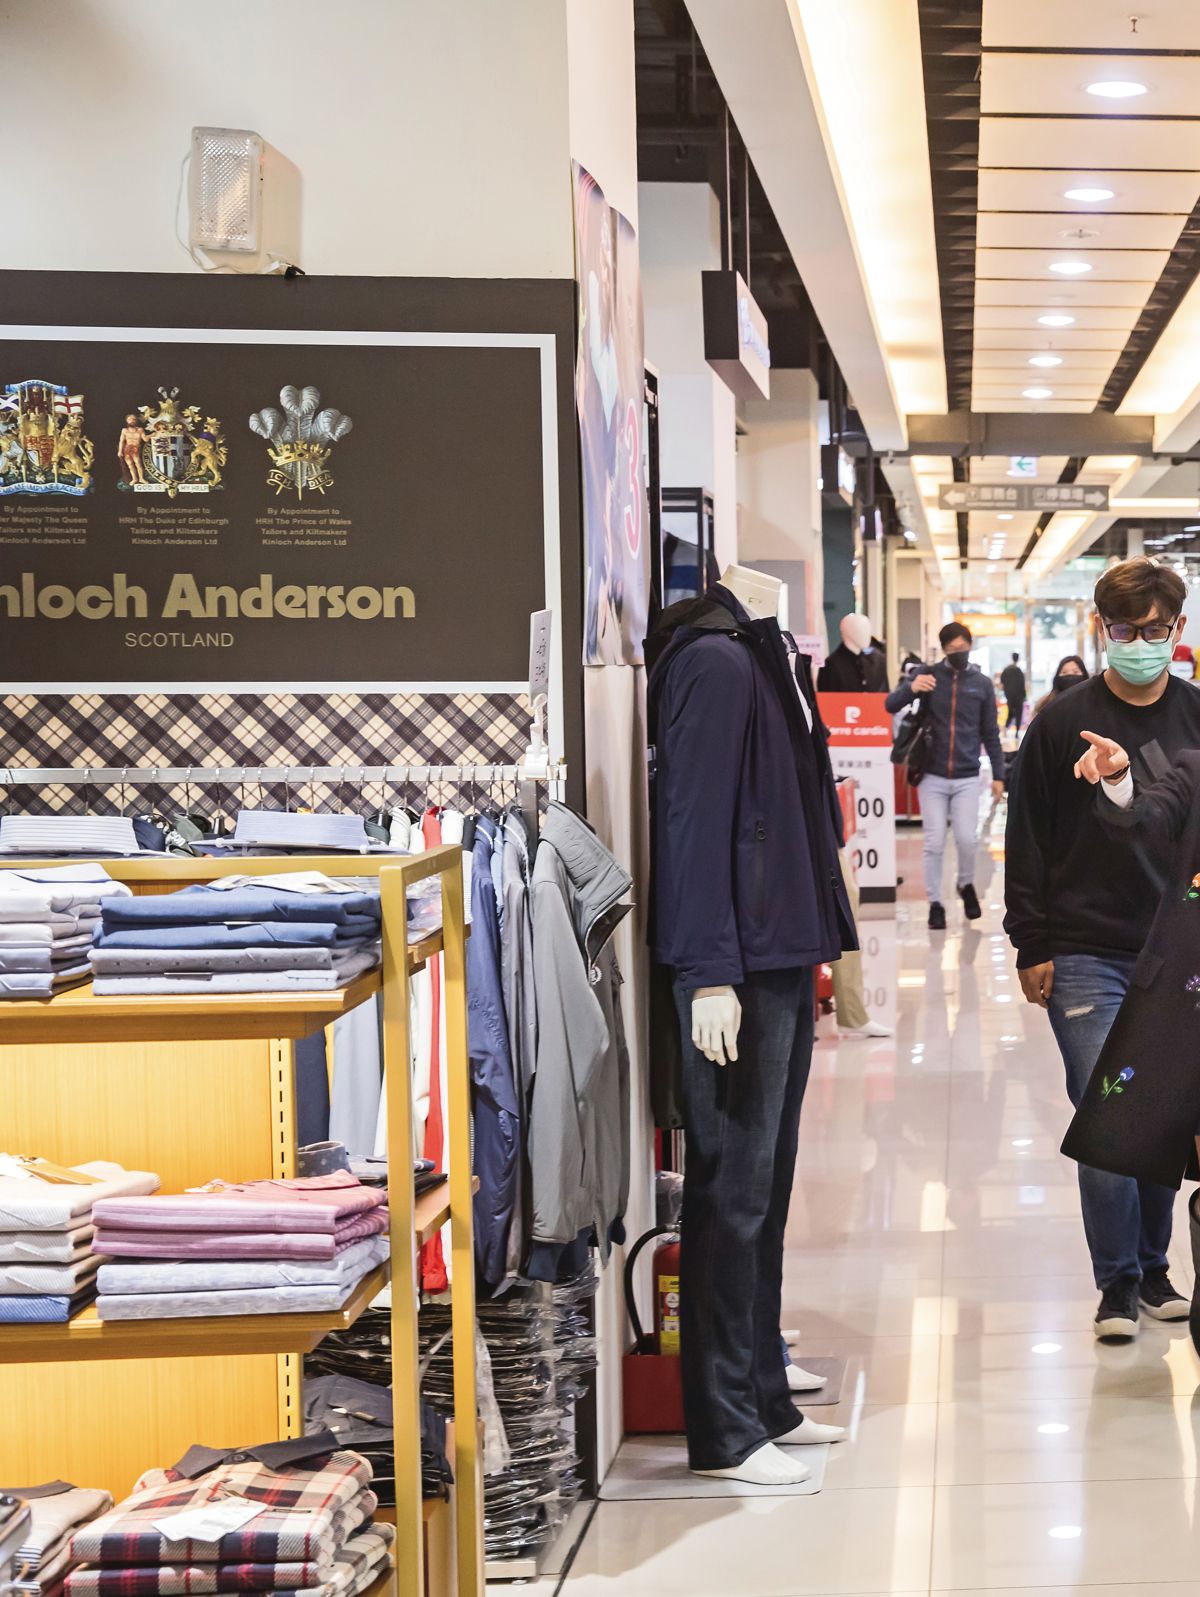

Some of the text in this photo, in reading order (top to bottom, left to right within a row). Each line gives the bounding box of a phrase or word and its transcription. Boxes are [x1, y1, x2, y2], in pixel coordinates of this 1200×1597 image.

[623, 398, 642, 560] 3
[4, 506, 15, 514] By
[17, 506, 69, 514] Appointment
[136, 506, 211, 514] By Appointment to
[267, 507, 278, 515] By
[280, 507, 330, 515] Appointment
[12, 516, 42, 525] Majesty
[44, 516, 60, 524] The
[62, 516, 88, 524] Queen
[188, 517, 229, 526] Edinburgh
[130, 527, 219, 535] Tailors and Kiltmakers
[261, 528, 348, 536] Tailors and Kiltmakers
[31, 537, 71, 545] Anderson
[262, 538, 348, 546] Kinloch Anderson Ltd
[0, 572, 416, 620] nloch Anderson
[124, 631, 235, 648] SCOTLAND
[857, 797, 885, 818] 00
